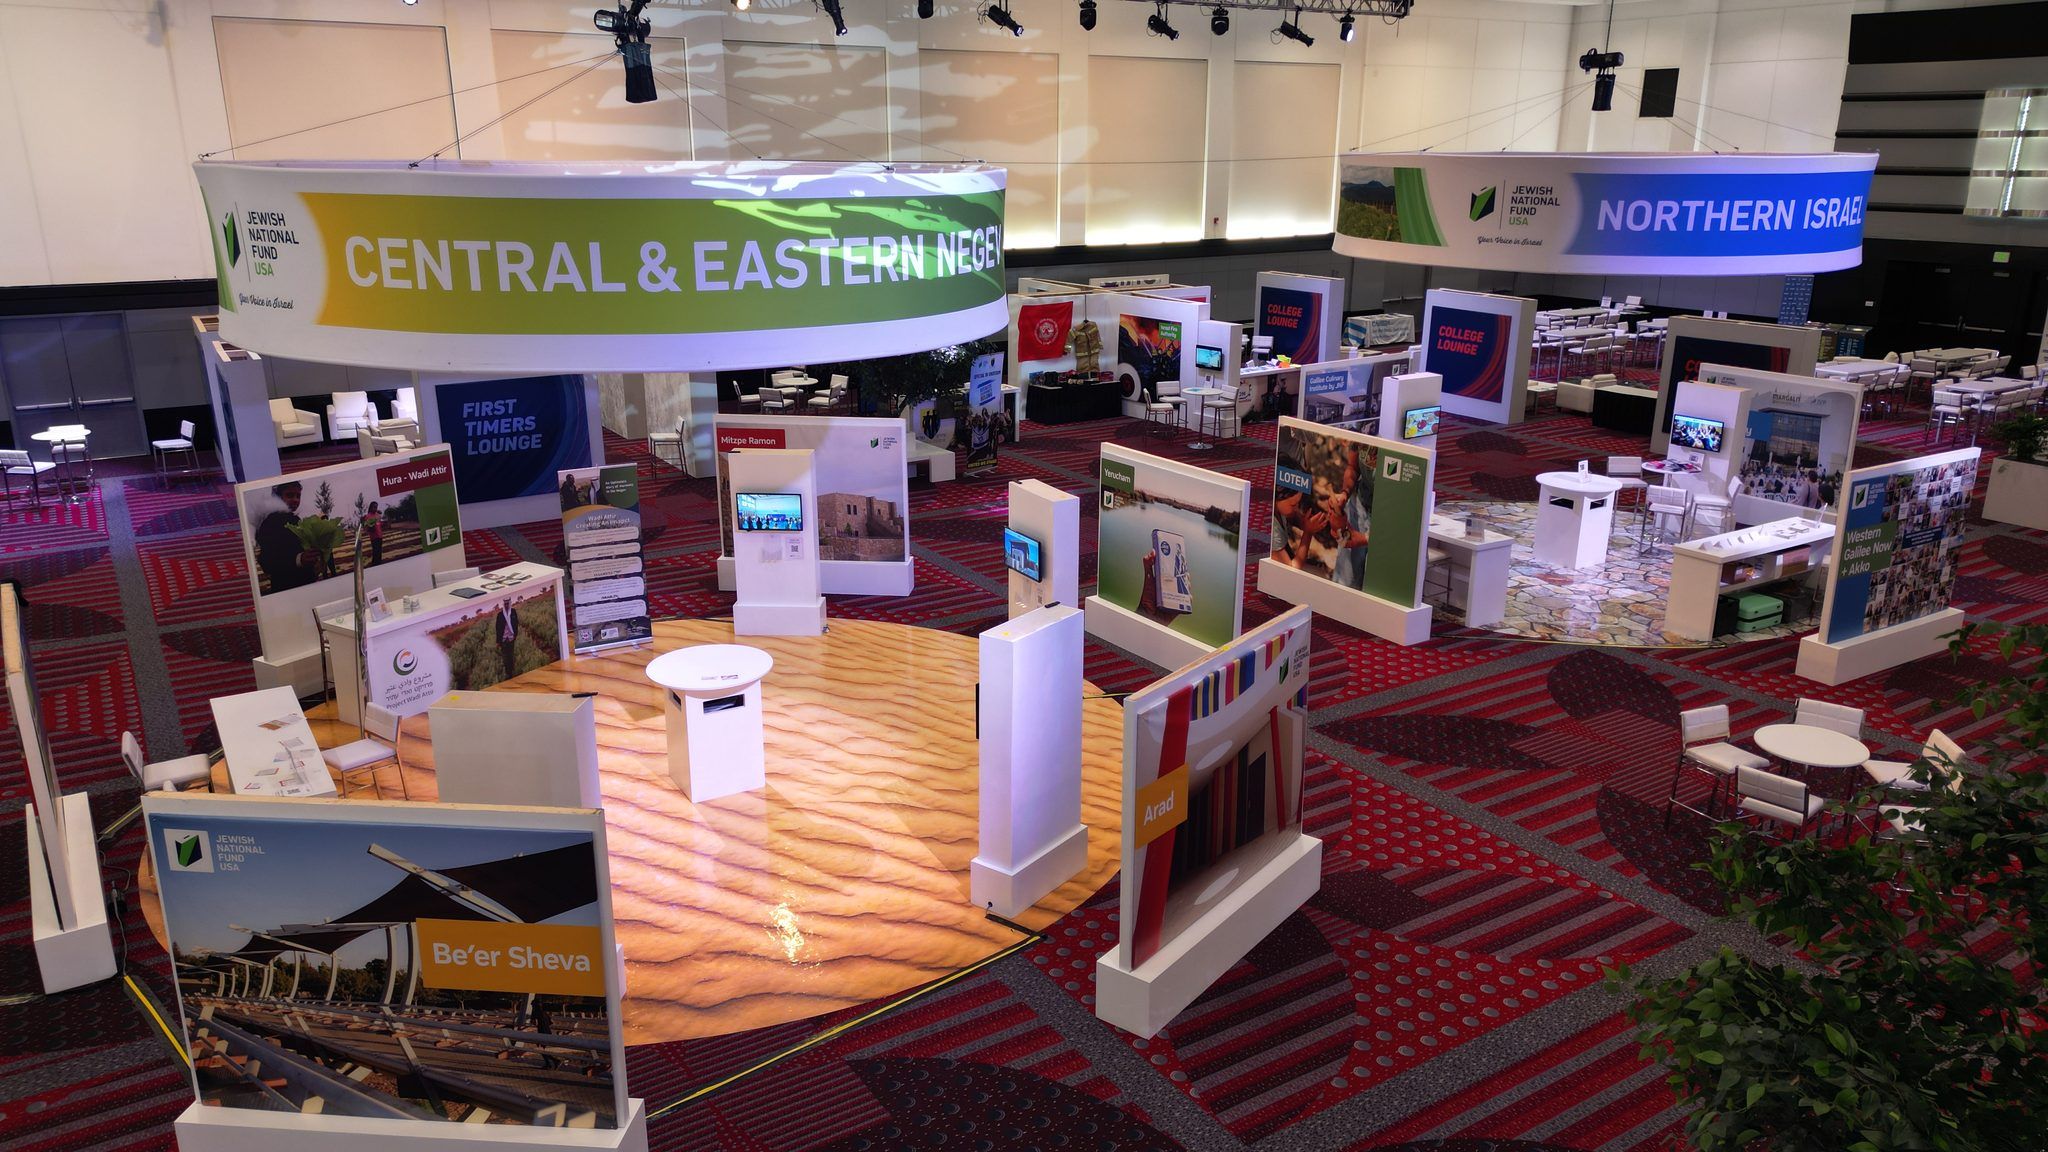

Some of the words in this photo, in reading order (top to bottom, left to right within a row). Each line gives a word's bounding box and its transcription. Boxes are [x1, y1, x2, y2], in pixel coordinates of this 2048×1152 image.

[1512, 186, 1553, 195] JEWISH
[1511, 196, 1560, 206] NATIONAL
[246, 211, 286, 226] JEWISH
[1509, 206, 1537, 216] FUND
[1597, 198, 1796, 231] NORTHERN
[1801, 194, 1864, 230] ISRAEL
[1508, 216, 1528, 226] USA
[248, 228, 300, 244] NATIONAL
[251, 245, 278, 260] FUND
[345, 235, 626, 293] CENTRAL
[636, 241, 682, 293] &
[693, 233, 925, 292] EASTERN
[937, 223, 1002, 278] NEGEV
[254, 262, 274, 276] USA
[272, 297, 295, 309] Israel
[1267, 303, 1303, 317] COLLEGE
[1267, 315, 1299, 329] LOUNGE
[1438, 325, 1486, 343] COLLEGE
[1436, 338, 1479, 356] LOUNGE
[462, 399, 518, 418] FIRST
[464, 416, 536, 437] TIMERS
[467, 433, 542, 456] LOUNGE
[721, 436, 747, 446] Mitzpe
[748, 436, 776, 445] Ramon
[382, 475, 403, 487] Hura
[408, 468, 429, 481] Wadi
[430, 464, 447, 476] Attir
[1104, 468, 1131, 483] Yerucham
[1279, 470, 1310, 489] LOTEM
[1847, 528, 1881, 544] Western
[1844, 545, 1871, 561] Galilee
[1873, 541, 1892, 554] Now
[1842, 568, 1847, 576] +
[1848, 561, 1870, 576] Akko
[1143, 790, 1174, 826] Arad
[216, 834, 255, 845] JEWISH
[217, 844, 265, 855] NATIONAL
[218, 853, 245, 863] FUND
[220, 863, 240, 871] USA
[432, 942, 501, 967] Be'er
[508, 946, 591, 972] Sheva
